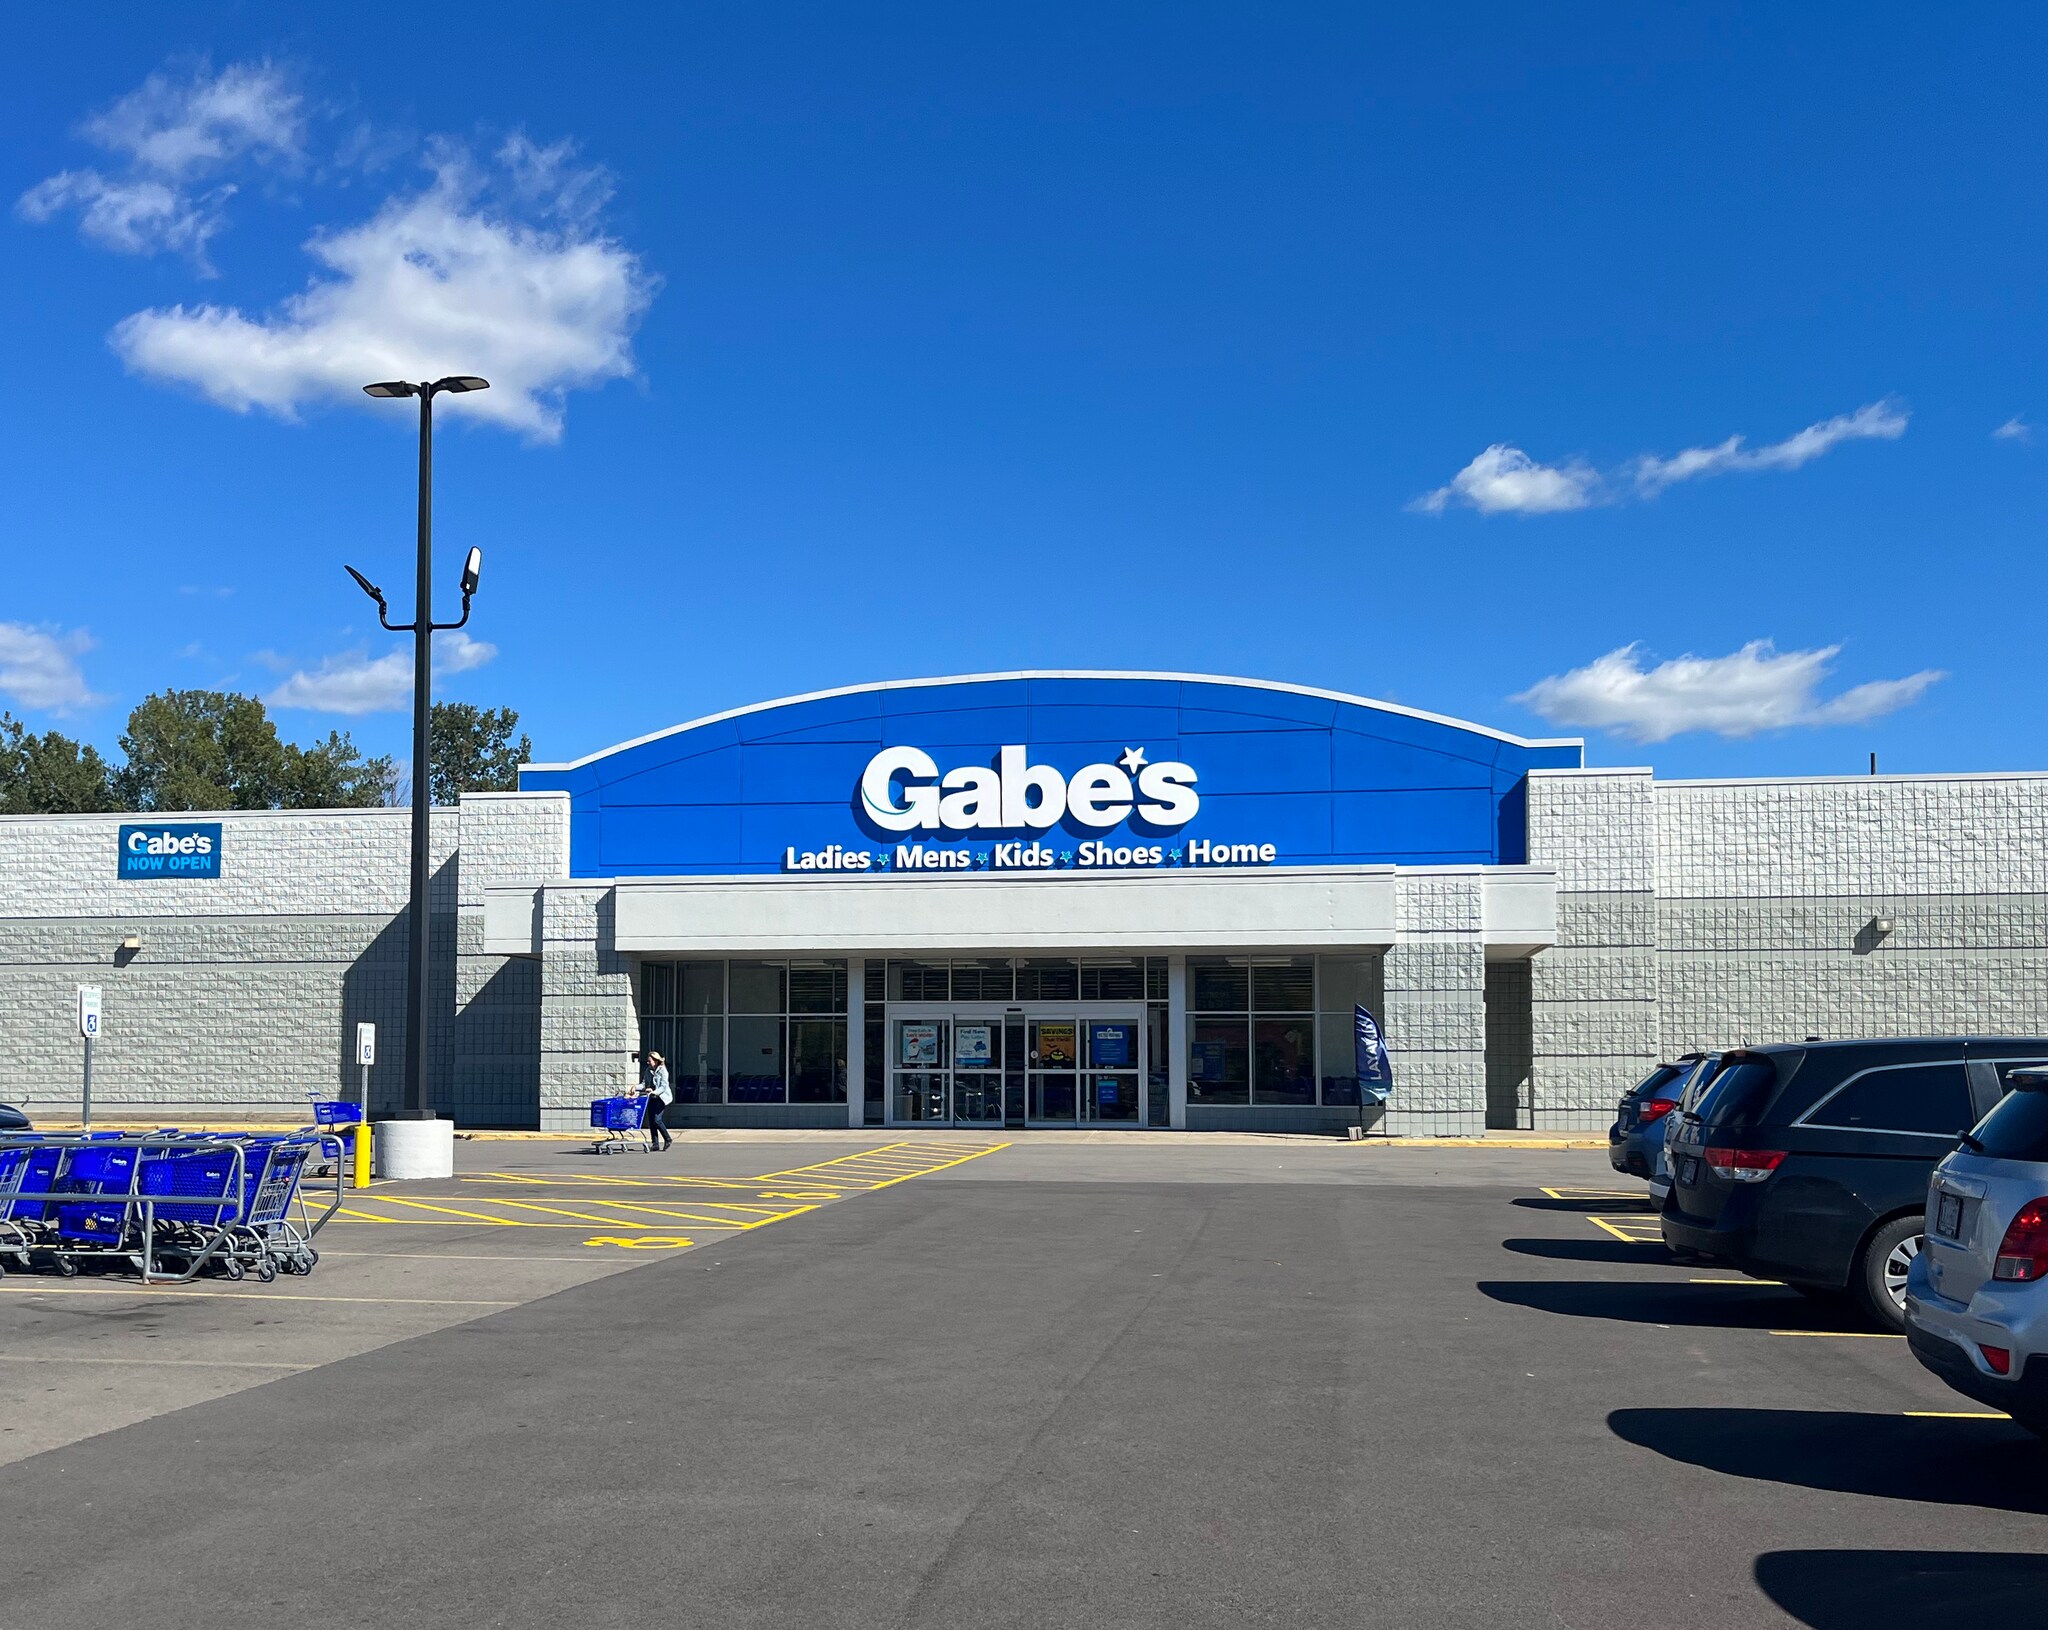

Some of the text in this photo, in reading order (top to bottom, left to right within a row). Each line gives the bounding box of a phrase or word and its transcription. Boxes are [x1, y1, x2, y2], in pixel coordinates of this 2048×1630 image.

[861, 744, 1200, 832] Gabe's
[128, 831, 212, 855] Gabe's
[786, 839, 1277, 870] Ladies Mens Kids Shoes Home
[127, 855, 211, 871] NOW OPEN
